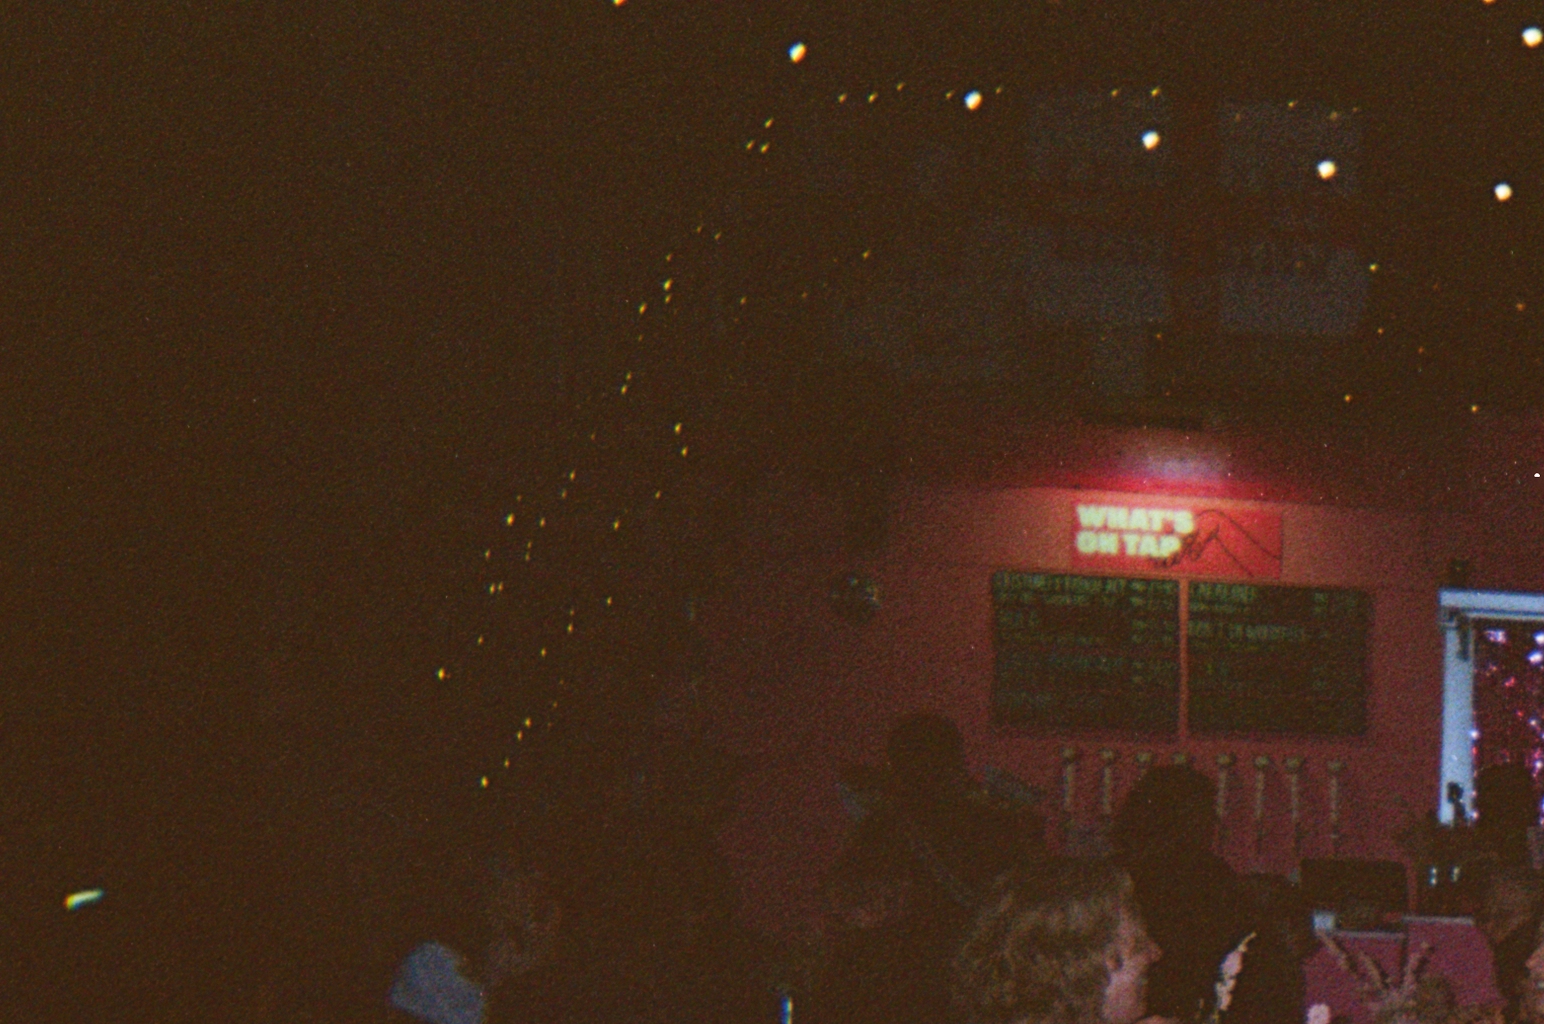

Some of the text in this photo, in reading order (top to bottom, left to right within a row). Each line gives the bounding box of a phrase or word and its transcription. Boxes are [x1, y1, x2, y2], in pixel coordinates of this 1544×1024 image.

[1077, 505, 1194, 534] WHAT'S
[1077, 531, 1182, 559] ON TAP
